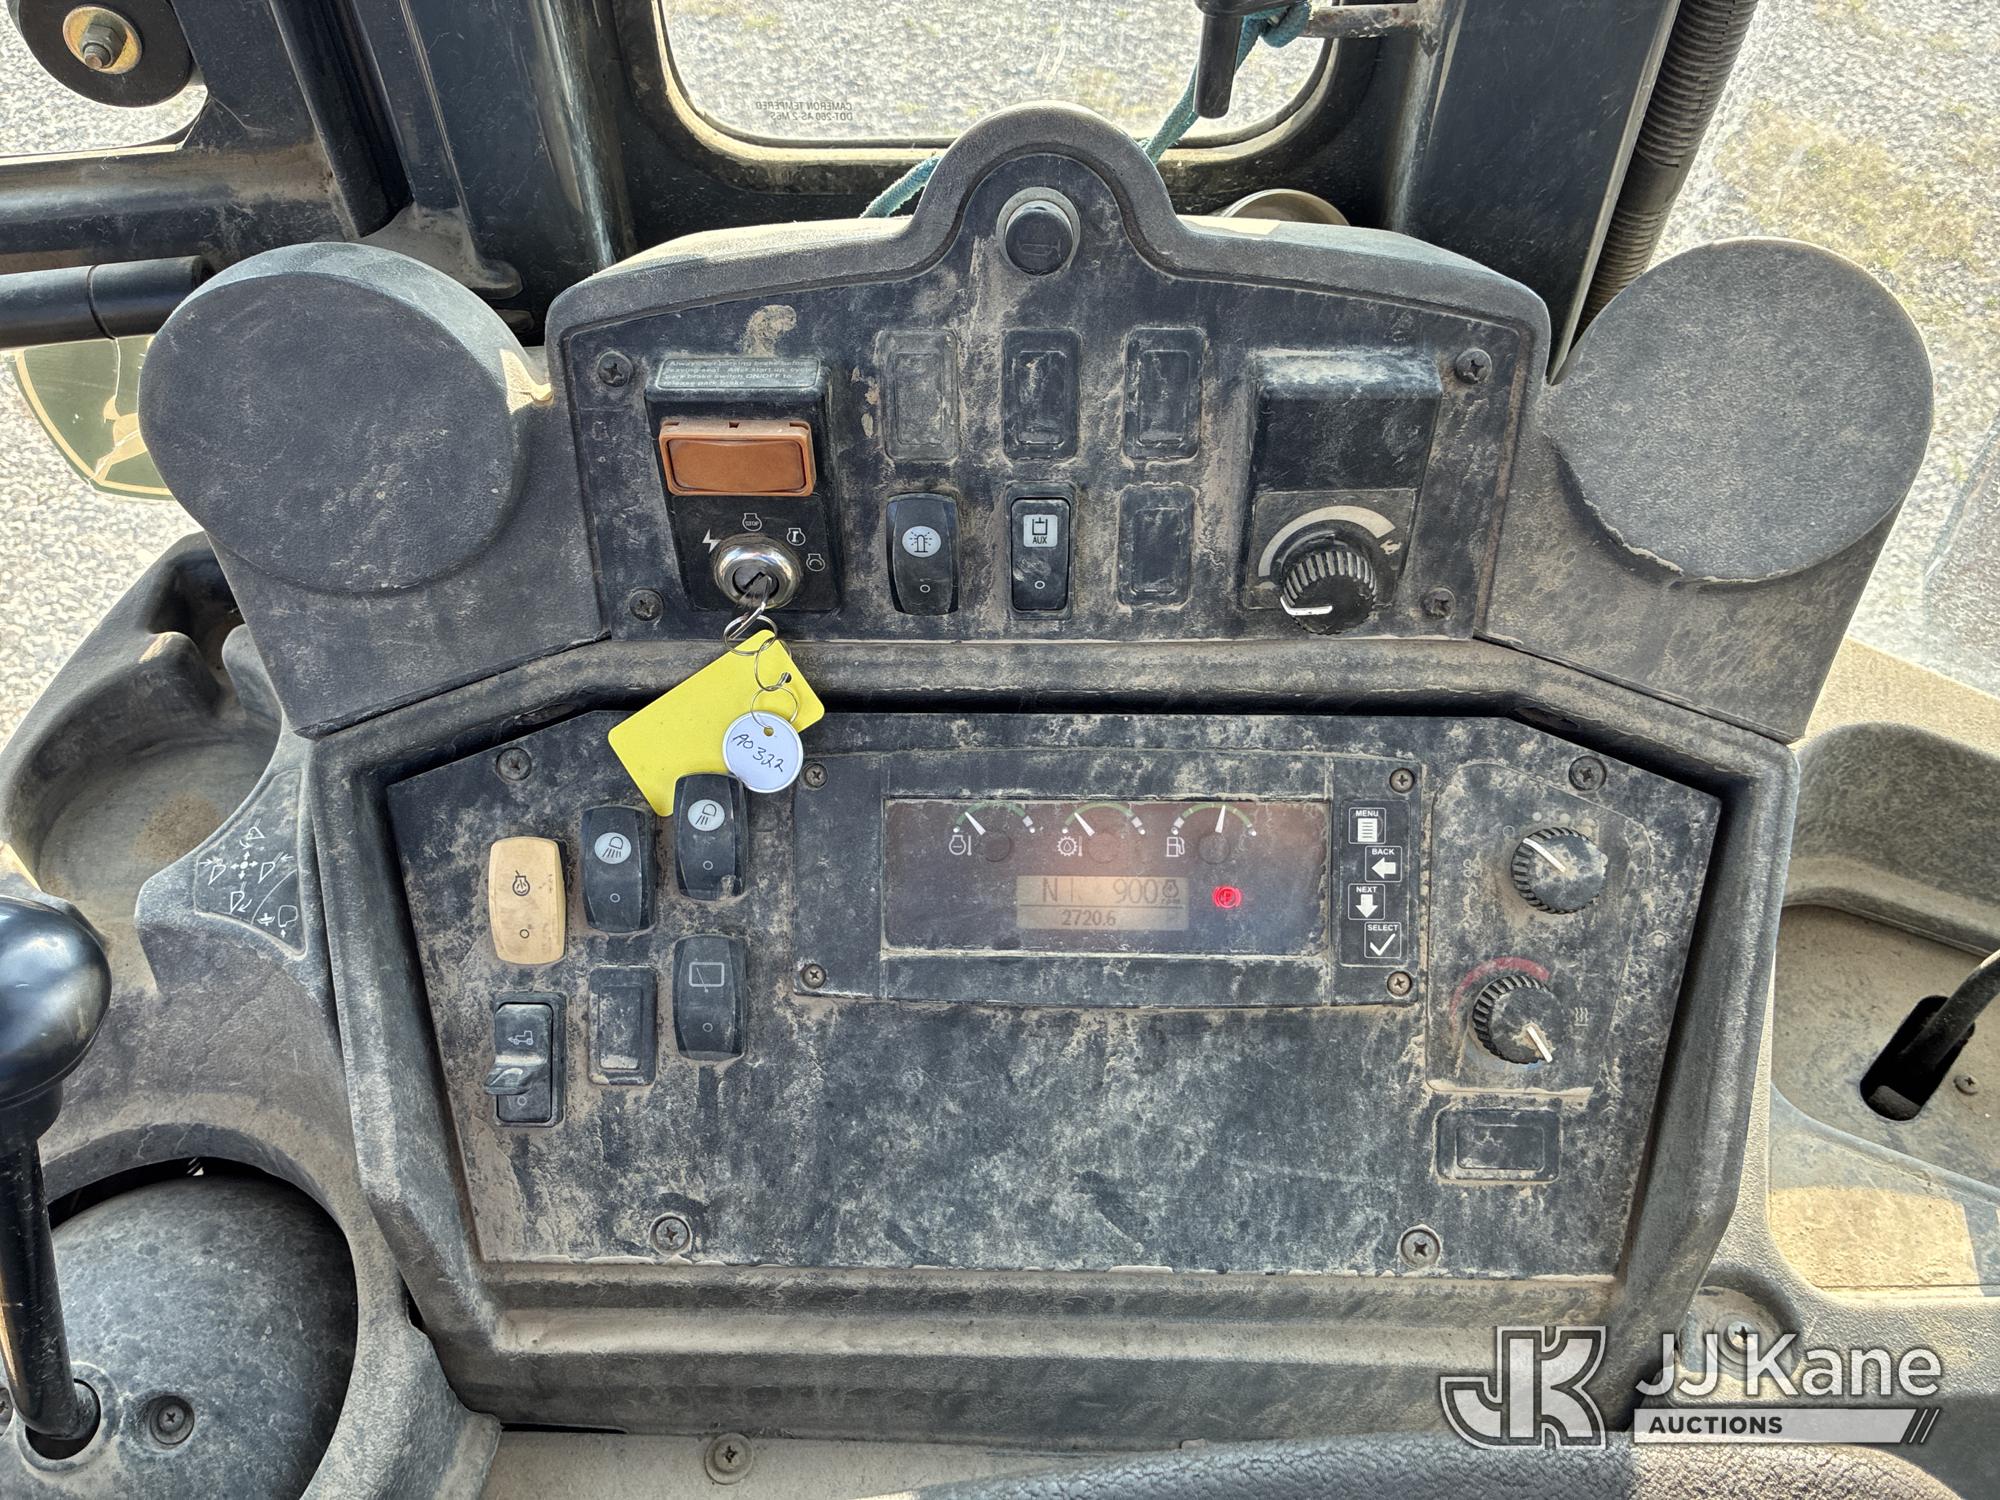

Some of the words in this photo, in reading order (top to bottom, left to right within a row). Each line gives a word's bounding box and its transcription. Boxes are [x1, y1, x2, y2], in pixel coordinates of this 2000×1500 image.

[1032, 536, 1048, 545] AUX
[1355, 809, 1379, 817] MENU
[1042, 877, 1058, 903] N
[1112, 878, 1159, 904] 900
[1061, 909, 1117, 927] 2720.6
[1367, 924, 1399, 932] SELECT
